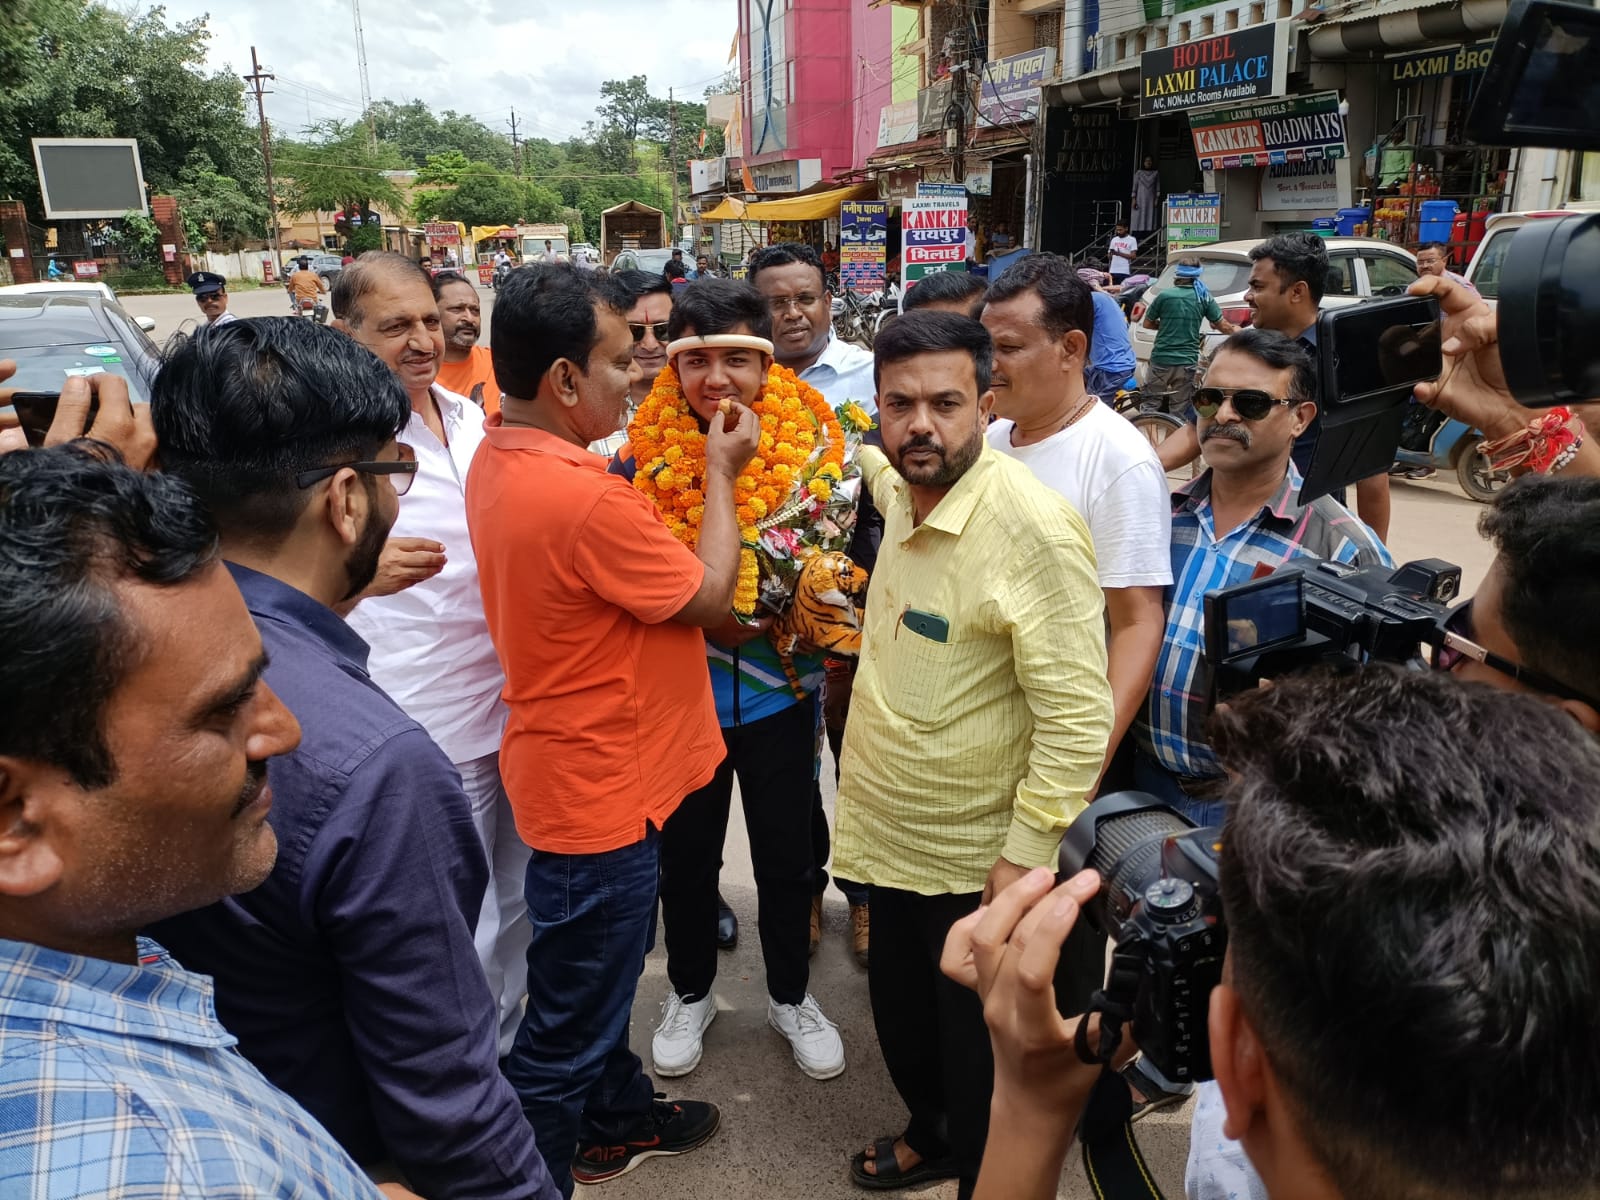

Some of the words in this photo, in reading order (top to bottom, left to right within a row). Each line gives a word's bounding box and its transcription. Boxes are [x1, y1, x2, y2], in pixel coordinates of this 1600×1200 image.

[1173, 36, 1236, 69] HOTEL
[1145, 69, 1196, 98] LAXMI
[1199, 55, 1268, 89] PALACE
[1393, 55, 1449, 80] LAXMI
[1167, 92, 1196, 109] NON-A/C
[1197, 89, 1222, 103] Rooms
[1222, 83, 1257, 98] Available
[1230, 109, 1253, 121] LAXMI
[1253, 104, 1287, 119] TRAVELS
[1195, 124, 1261, 153] KANKER
[1262, 112, 1341, 145] ROADWAYS
[864, 204, 884, 214] पायल
[1170, 207, 1216, 224] KANKER
[903, 210, 968, 229] KANKER
[912, 229, 960, 243] रायपुर
[583, 1145, 626, 1162] AIR
